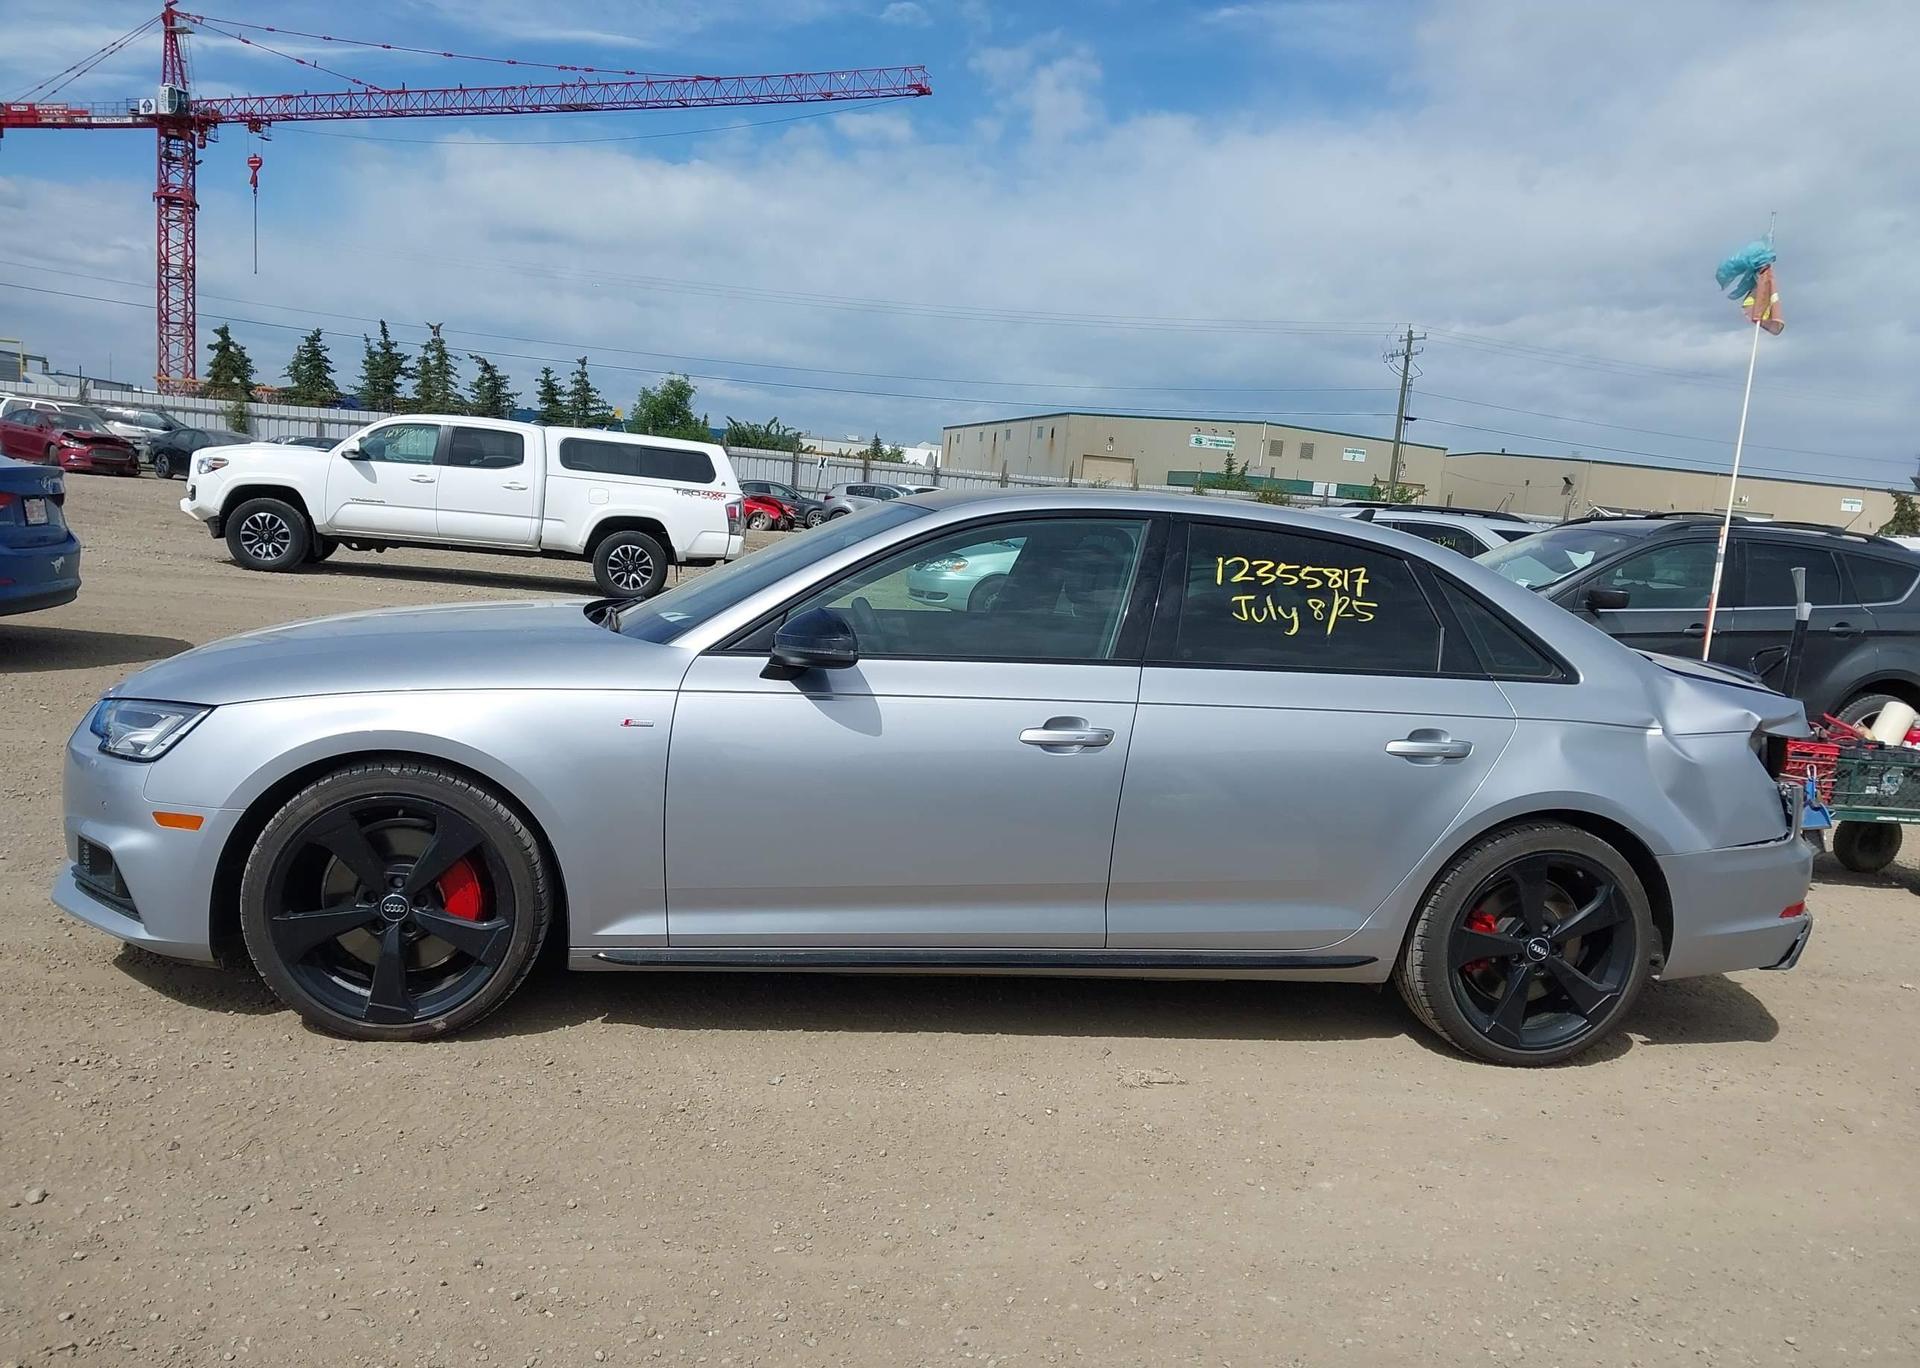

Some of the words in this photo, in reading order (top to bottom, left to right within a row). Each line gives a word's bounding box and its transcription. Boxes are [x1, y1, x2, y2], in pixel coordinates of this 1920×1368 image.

[819, 456, 827, 469] X
[1216, 556, 1370, 597] 12355817
[1231, 594, 1300, 636] July
[1306, 589, 1379, 636] 8/25
